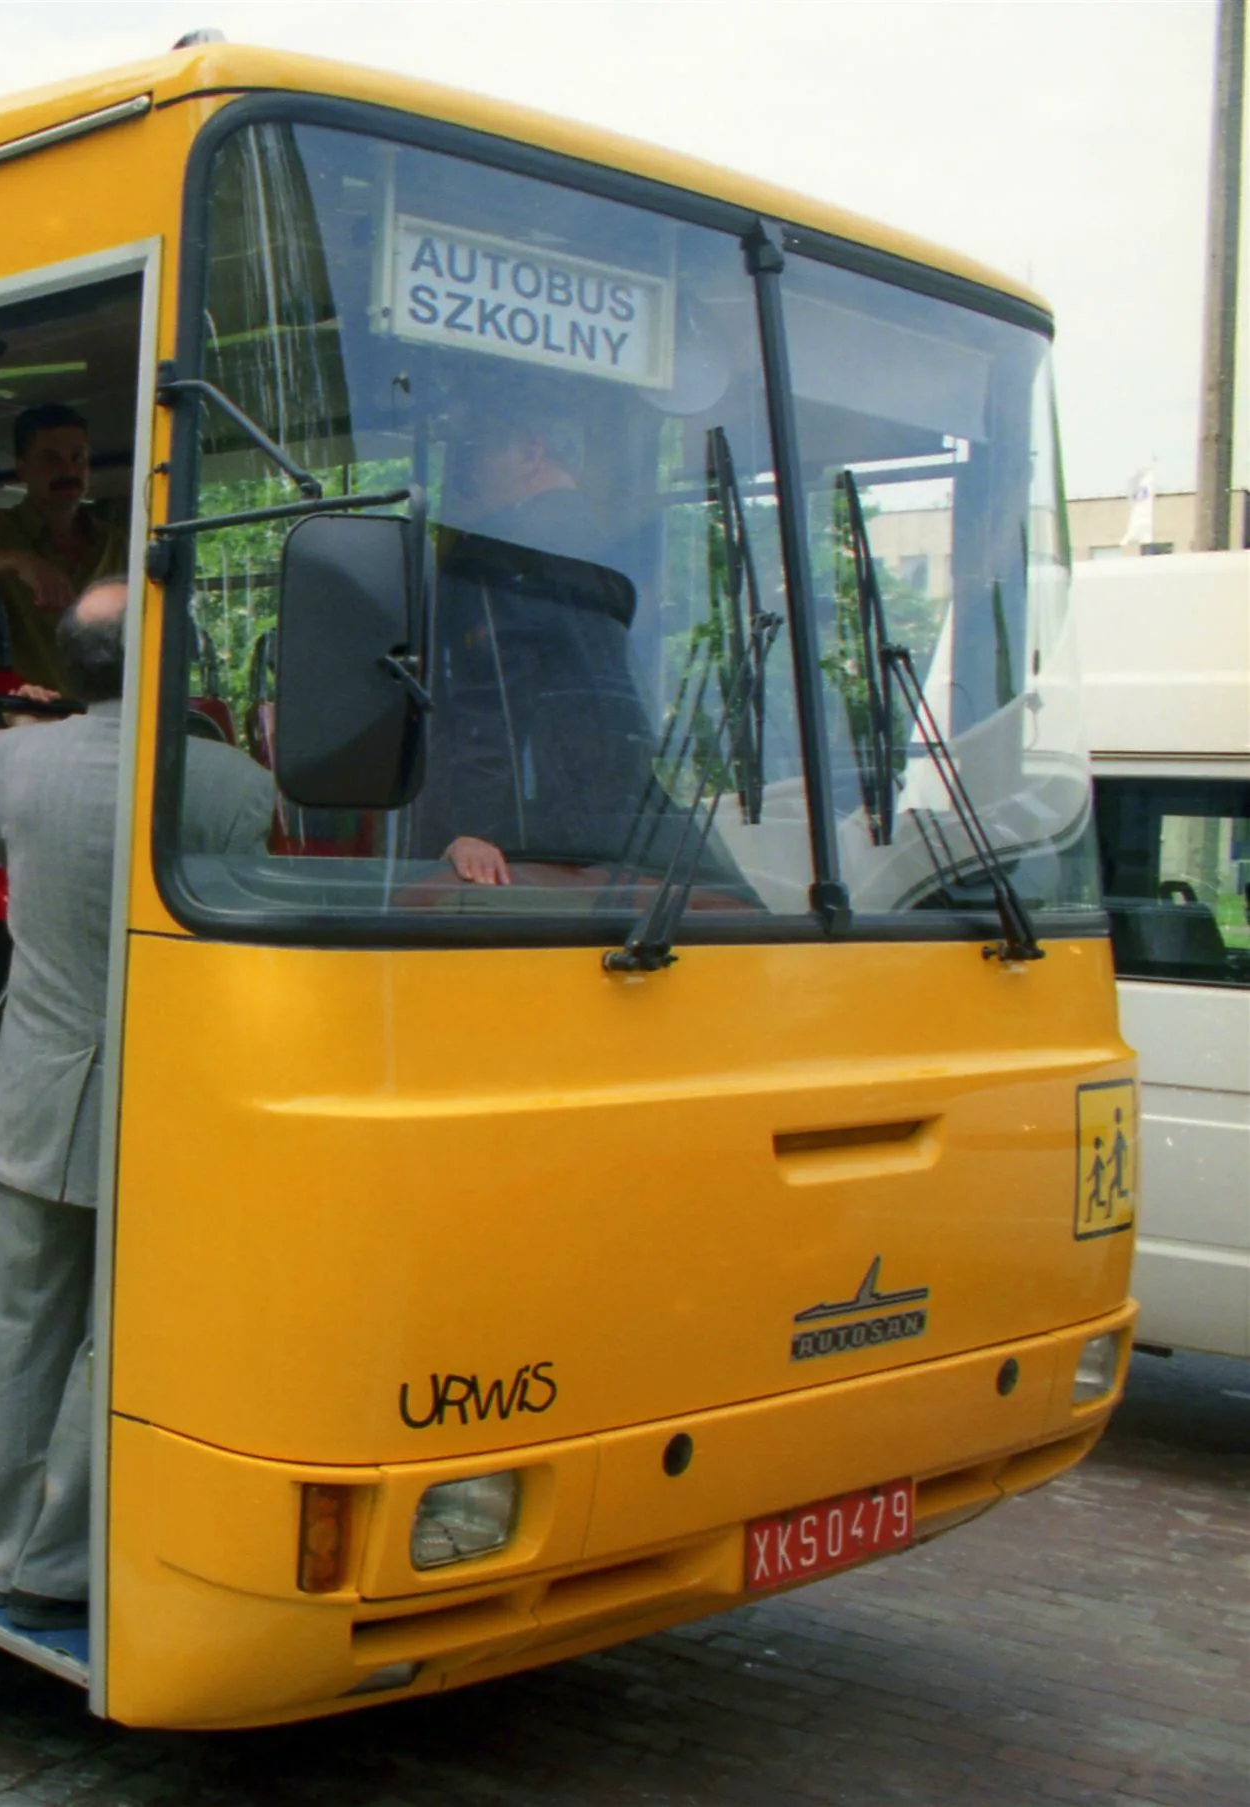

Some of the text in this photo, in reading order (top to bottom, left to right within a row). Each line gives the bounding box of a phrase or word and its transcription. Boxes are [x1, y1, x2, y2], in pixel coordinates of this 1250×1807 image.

[410, 236, 635, 322] AUTOBUS
[408, 284, 628, 365] SZKOLNY
[798, 1314, 920, 1357] AUTOSAN
